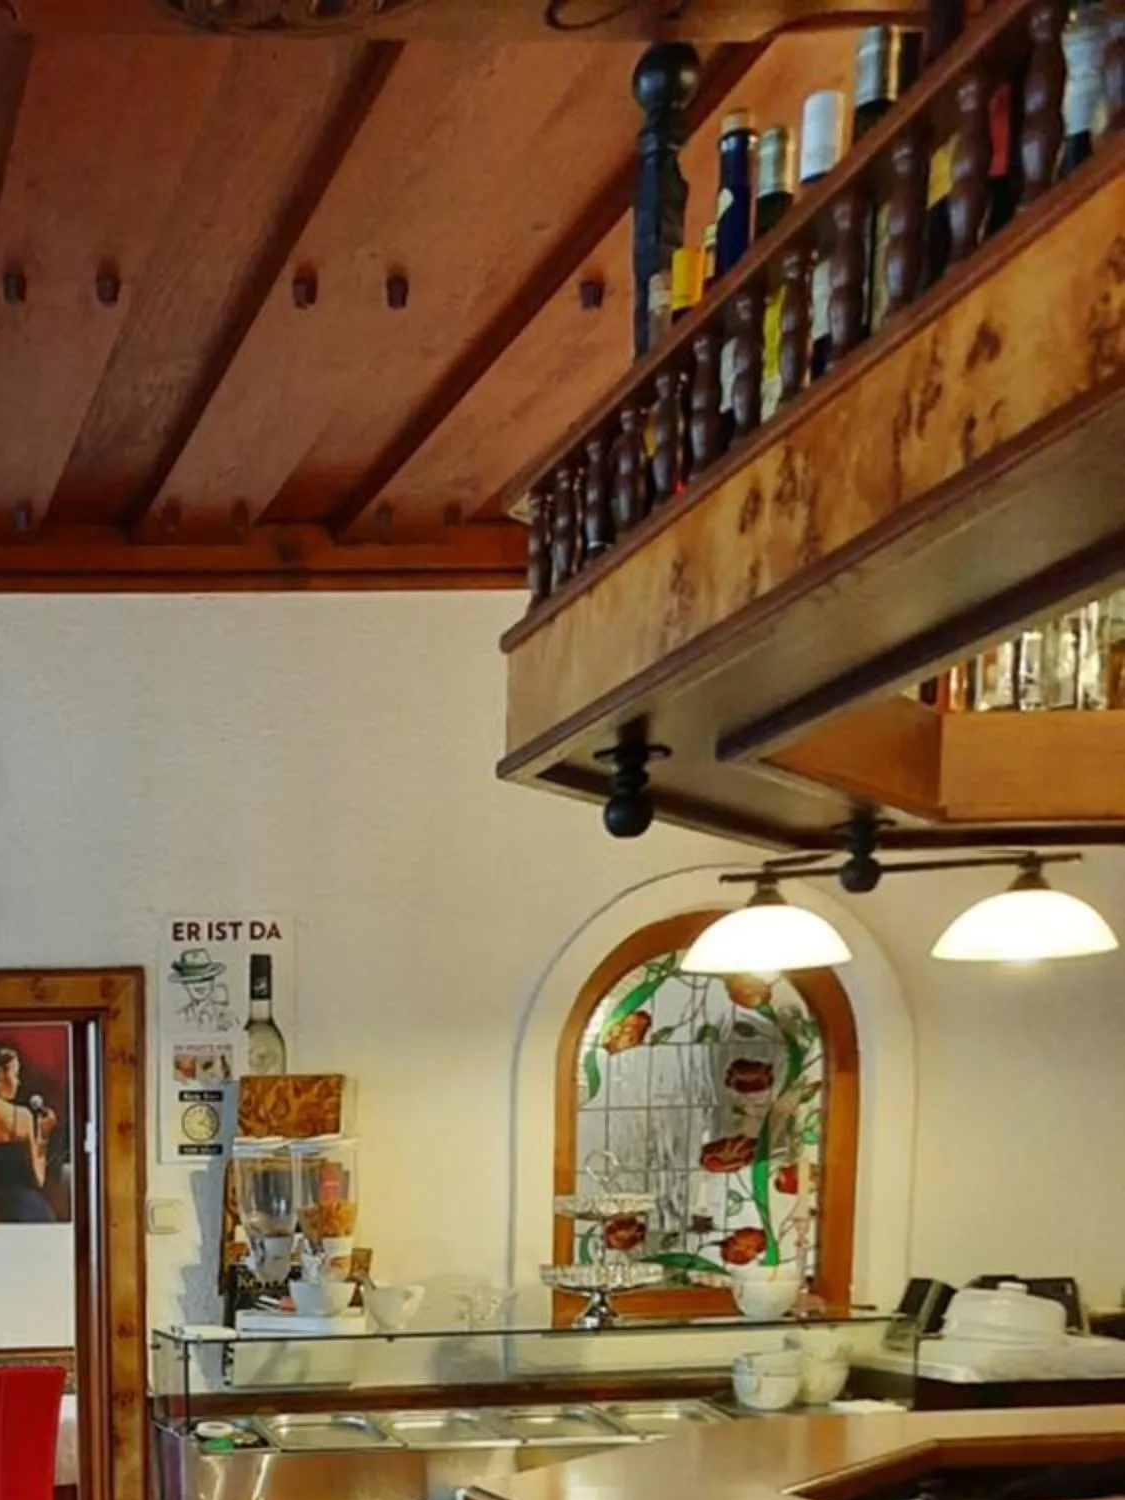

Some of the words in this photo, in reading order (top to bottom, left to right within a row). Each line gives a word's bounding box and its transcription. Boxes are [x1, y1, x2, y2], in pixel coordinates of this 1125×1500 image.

[172, 921, 201, 941] ER
[208, 921, 243, 941] IST
[250, 921, 282, 940] DA
